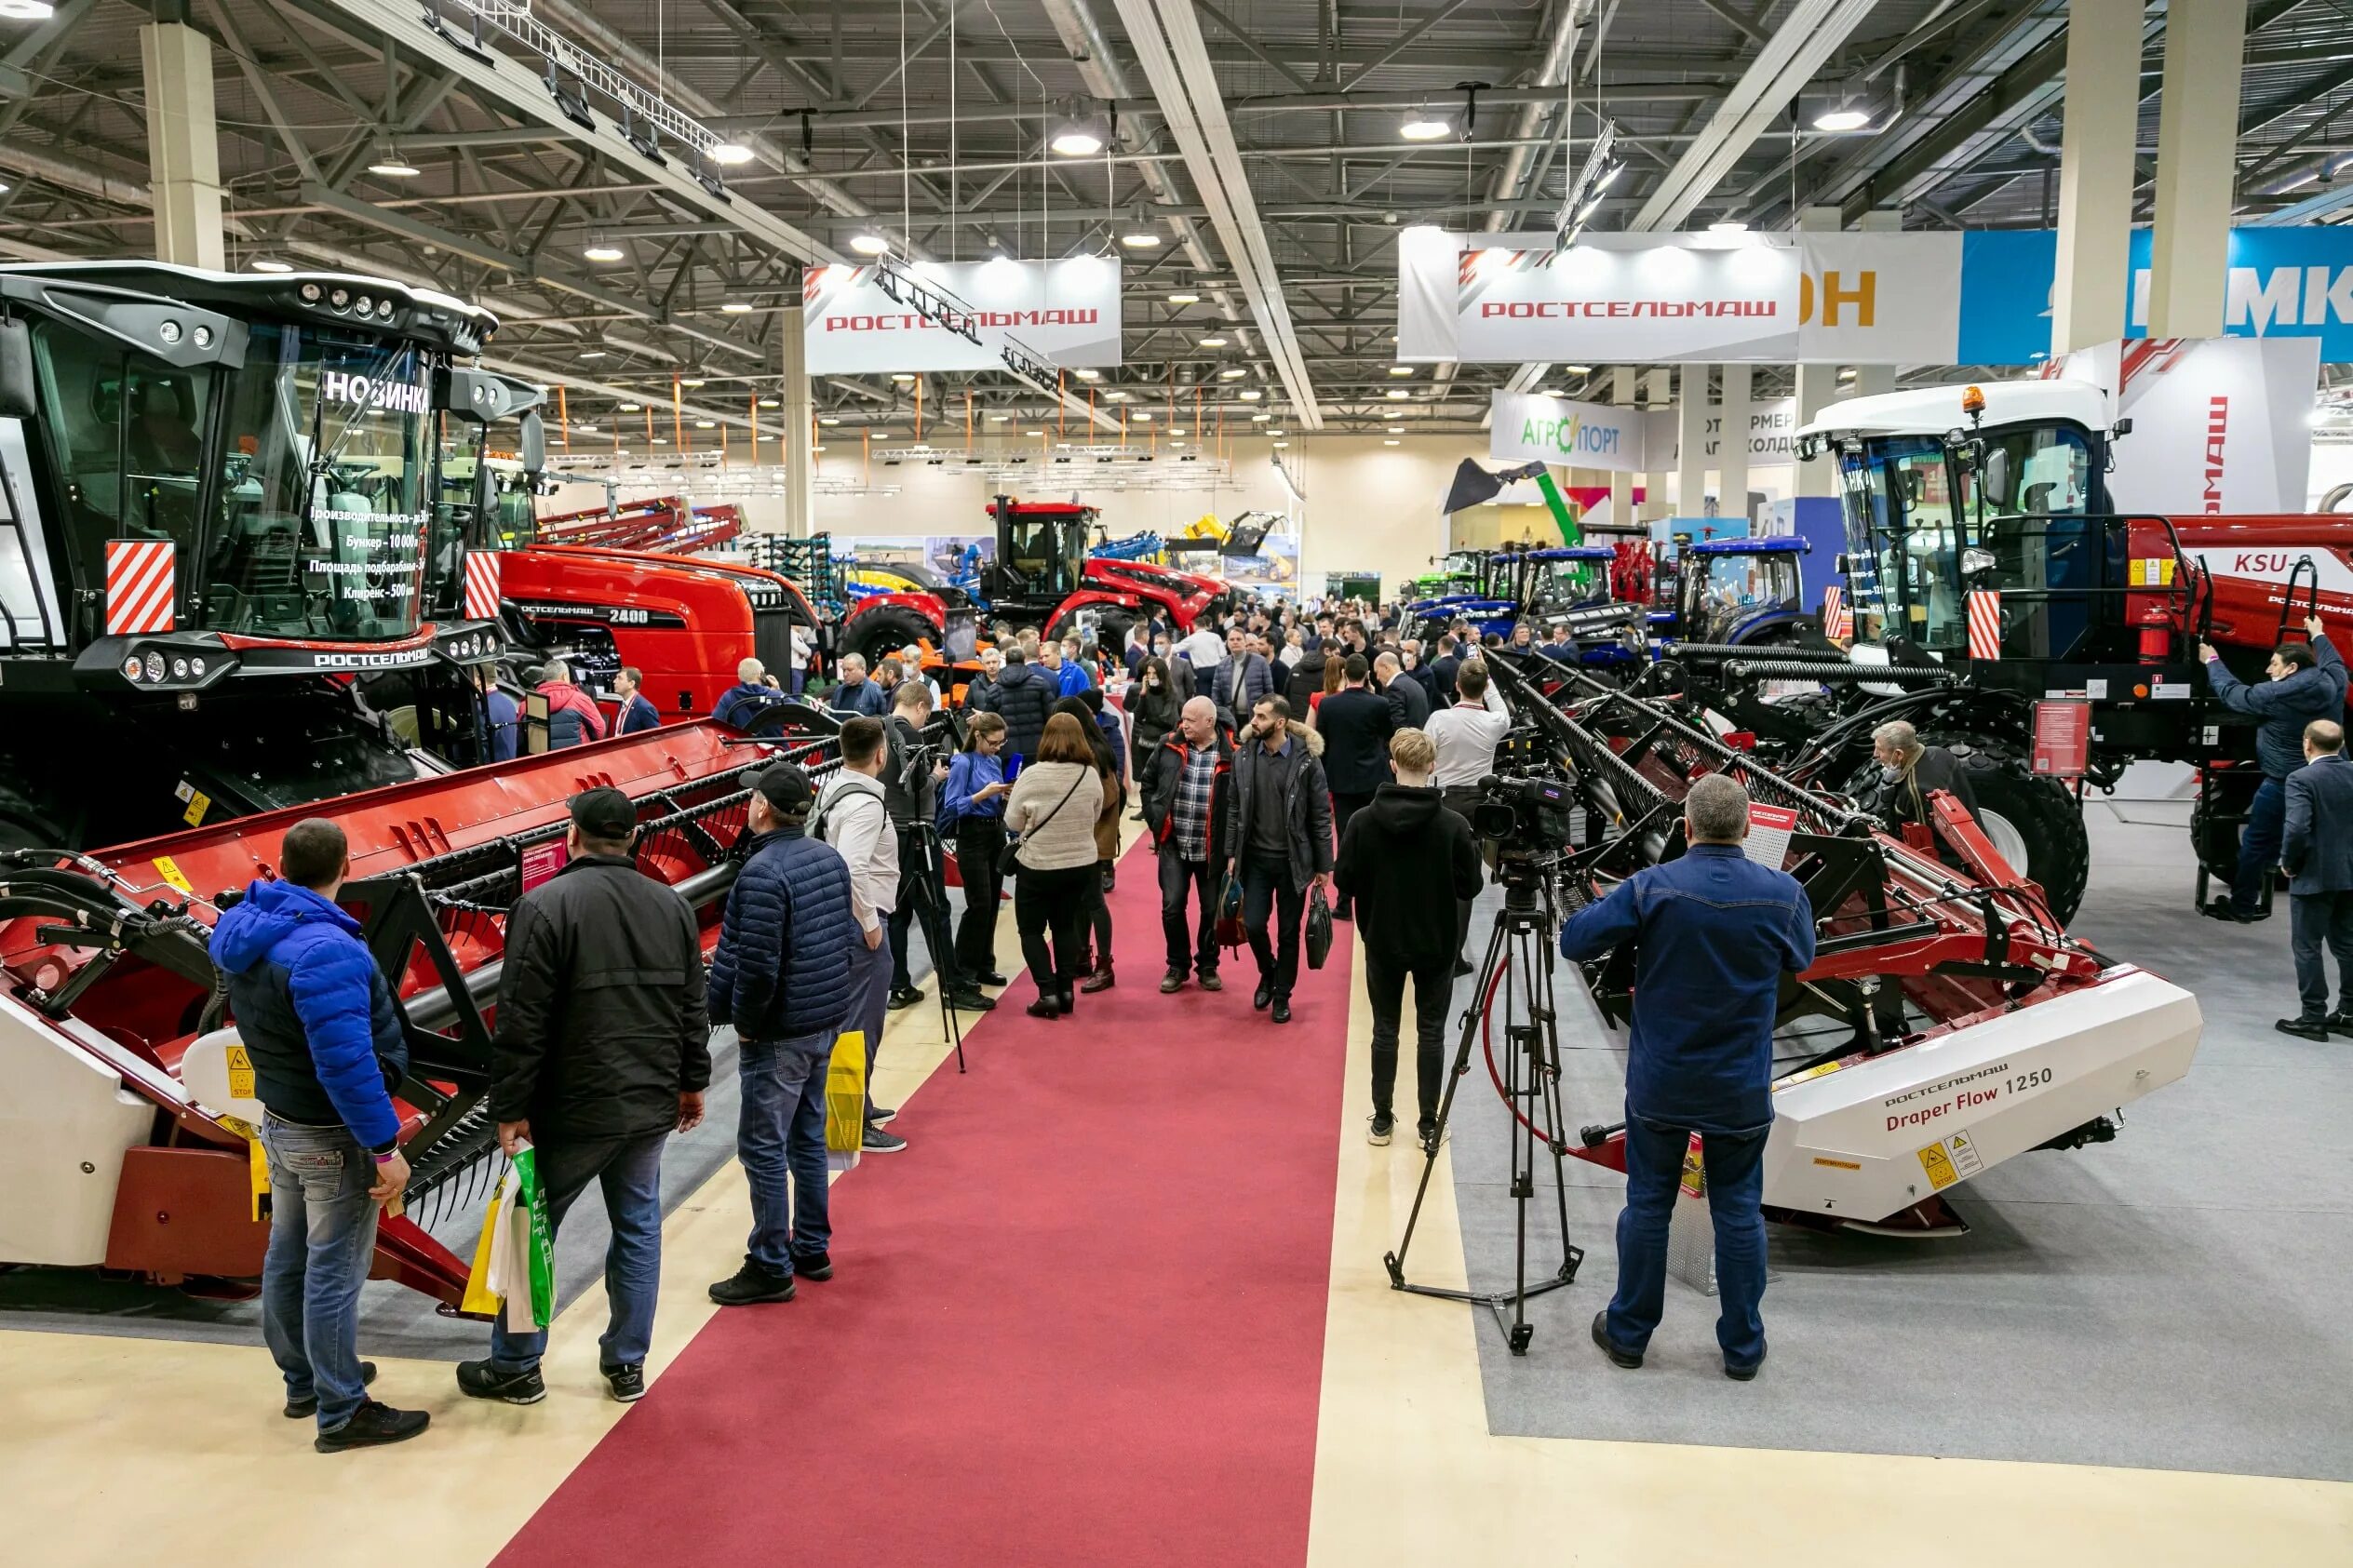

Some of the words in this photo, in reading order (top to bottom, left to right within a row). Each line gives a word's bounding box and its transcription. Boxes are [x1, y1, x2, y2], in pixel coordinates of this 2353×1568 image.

[1482, 301, 1776, 318] РОСТСЕЛЬМАШ
[827, 308, 1097, 331] РОСТСЕЛЬМАШ
[326, 371, 429, 414] НОВИНКА
[1750, 413, 1794, 430] РМЕР
[346, 535, 382, 550] Бункер
[310, 559, 362, 575] Площадь
[344, 587, 384, 601] Клиренс
[391, 583, 405, 596] 500
[521, 605, 594, 615] ОСТСЕЛЬМАШ
[610, 609, 649, 623] 2400
[315, 648, 428, 667] РОСТСЕЛЬМАШ
[1885, 1063, 2009, 1107] РОСТСЕЛЬМАШ
[1887, 1102, 1952, 1132] Draper
[1956, 1088, 1998, 1110] Flow
[2006, 1067, 2052, 1094] 1250
[1936, 1174, 1953, 1186] STOP
